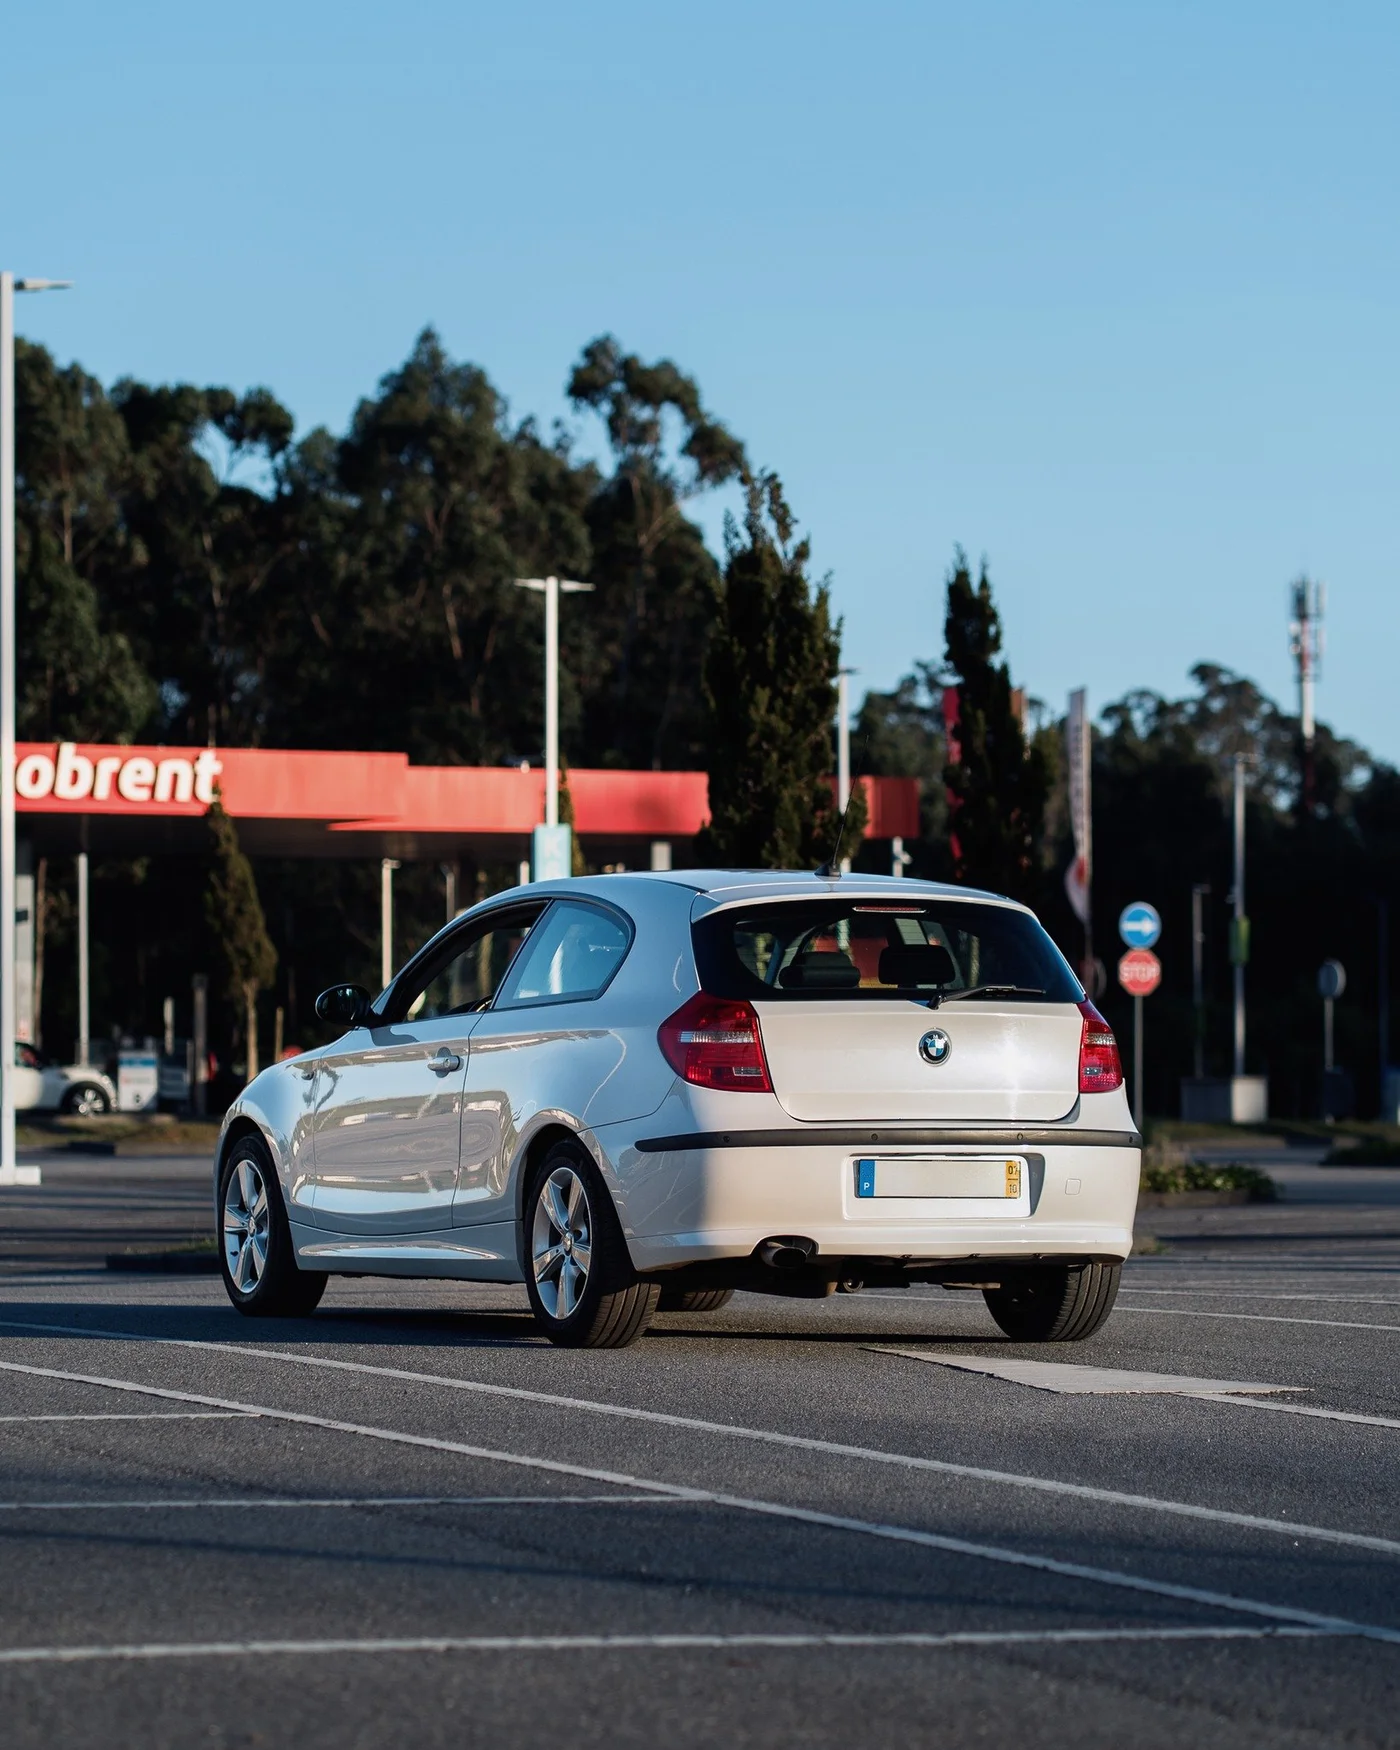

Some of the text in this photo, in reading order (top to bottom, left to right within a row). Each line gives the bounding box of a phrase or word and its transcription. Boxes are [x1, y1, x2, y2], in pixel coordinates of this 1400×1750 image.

[15, 742, 222, 803] obrent
[1120, 962, 1160, 982] STOP
[863, 1182, 870, 1191] P
[1009, 1184, 1018, 1194] 10
